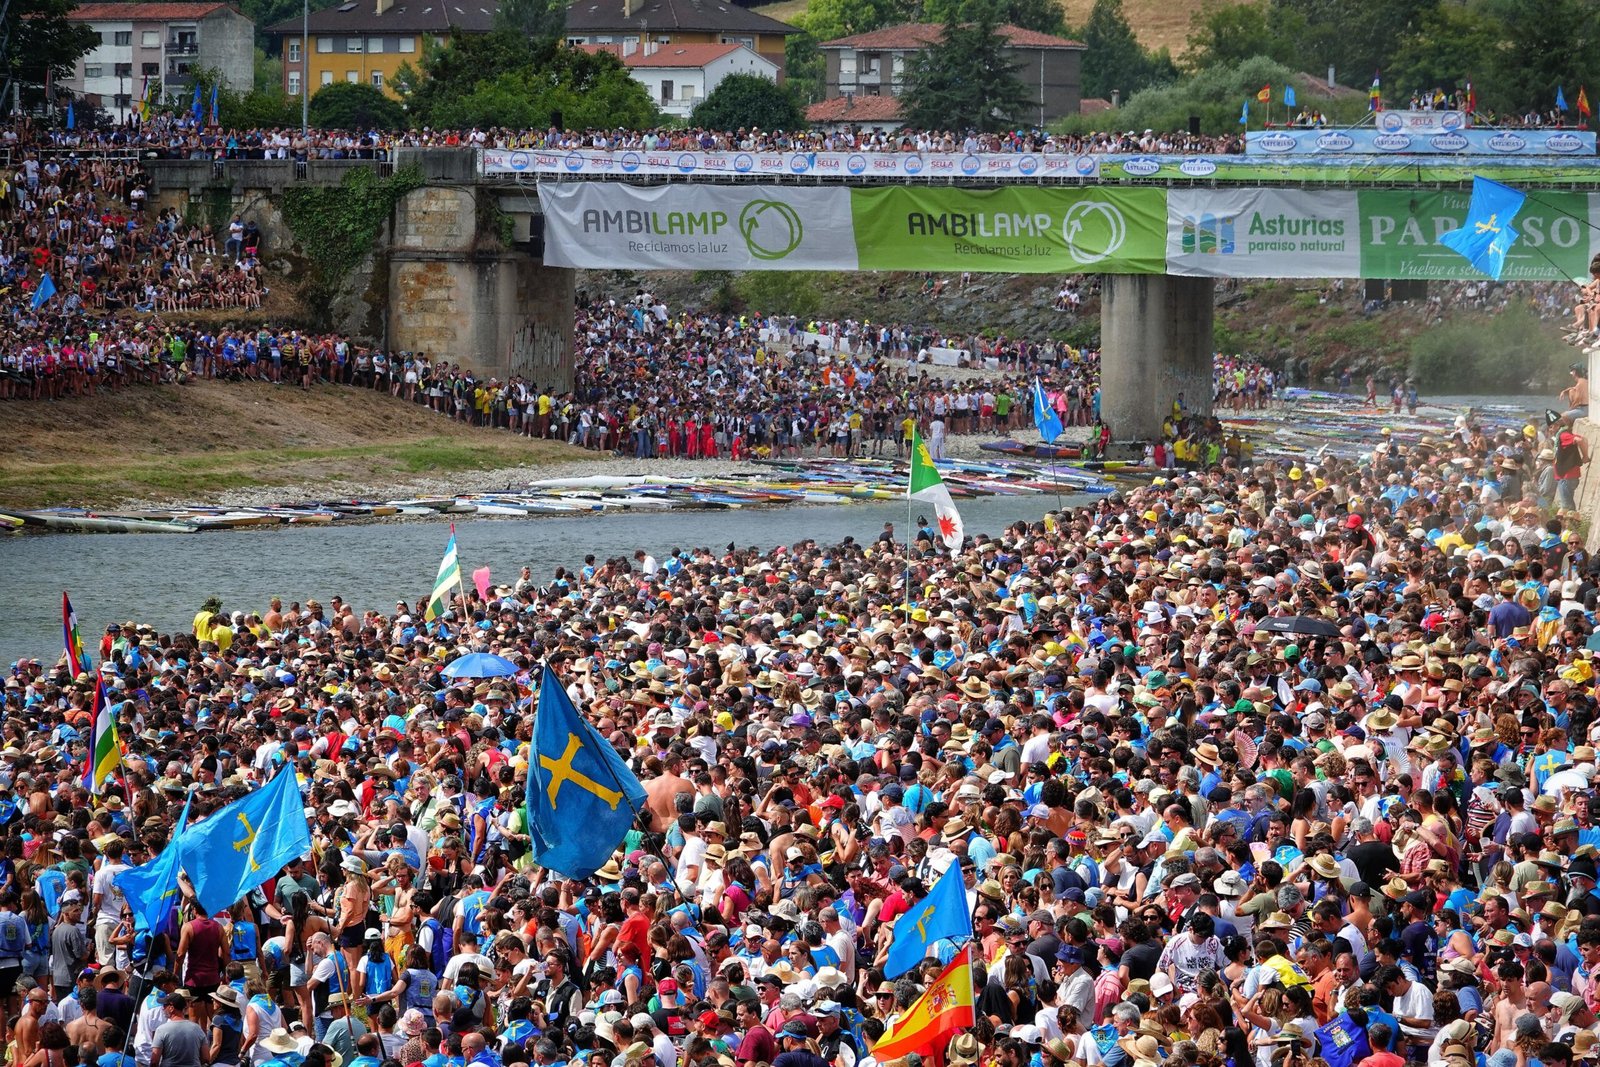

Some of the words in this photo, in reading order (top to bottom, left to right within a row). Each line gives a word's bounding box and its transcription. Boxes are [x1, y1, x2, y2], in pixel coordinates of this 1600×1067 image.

[536, 157, 558, 165] SELLA
[817, 160, 840, 168] SELLA
[874, 160, 896, 168] SELLA
[583, 209, 728, 235] AMBILAMP
[908, 212, 1051, 237] AMBILAMP
[1248, 211, 1345, 236] Asturias
[628, 240, 694, 253] Reciclamos
[954, 242, 1020, 256] Reciclamos
[1300, 240, 1345, 252] natural
[1400, 261, 1444, 276] Vuelve
[1447, 266, 1456, 276] a
[1502, 262, 1558, 278] Asturias
